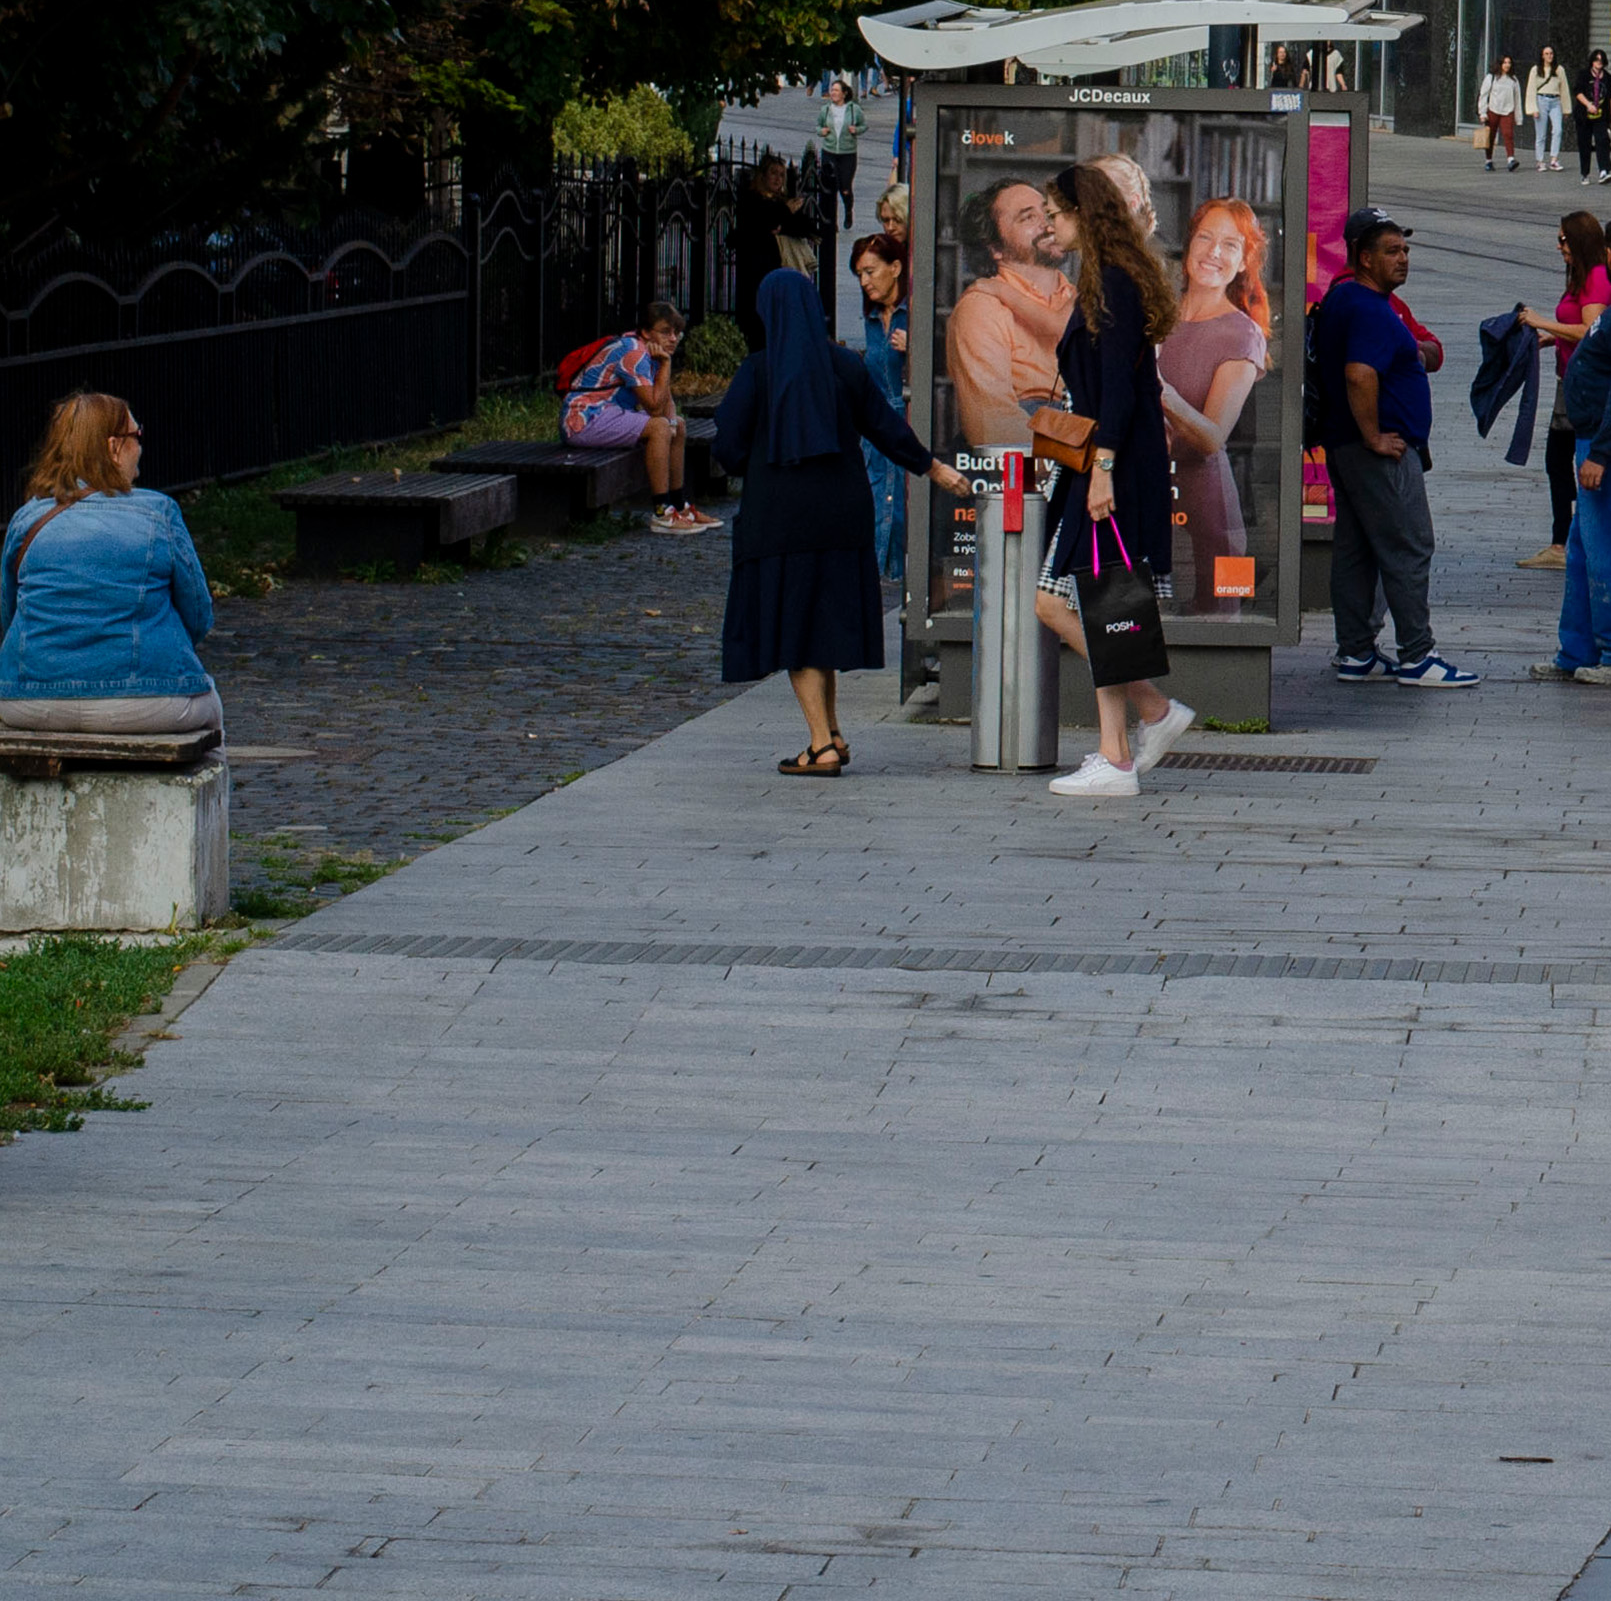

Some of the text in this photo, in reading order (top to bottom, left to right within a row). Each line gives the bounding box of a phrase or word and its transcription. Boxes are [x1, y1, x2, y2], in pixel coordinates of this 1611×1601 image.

[1069, 88, 1151, 104] JCDecaux
[961, 130, 1015, 145] človek
[1216, 585, 1251, 596] orange
[1105, 619, 1134, 634] POSH
